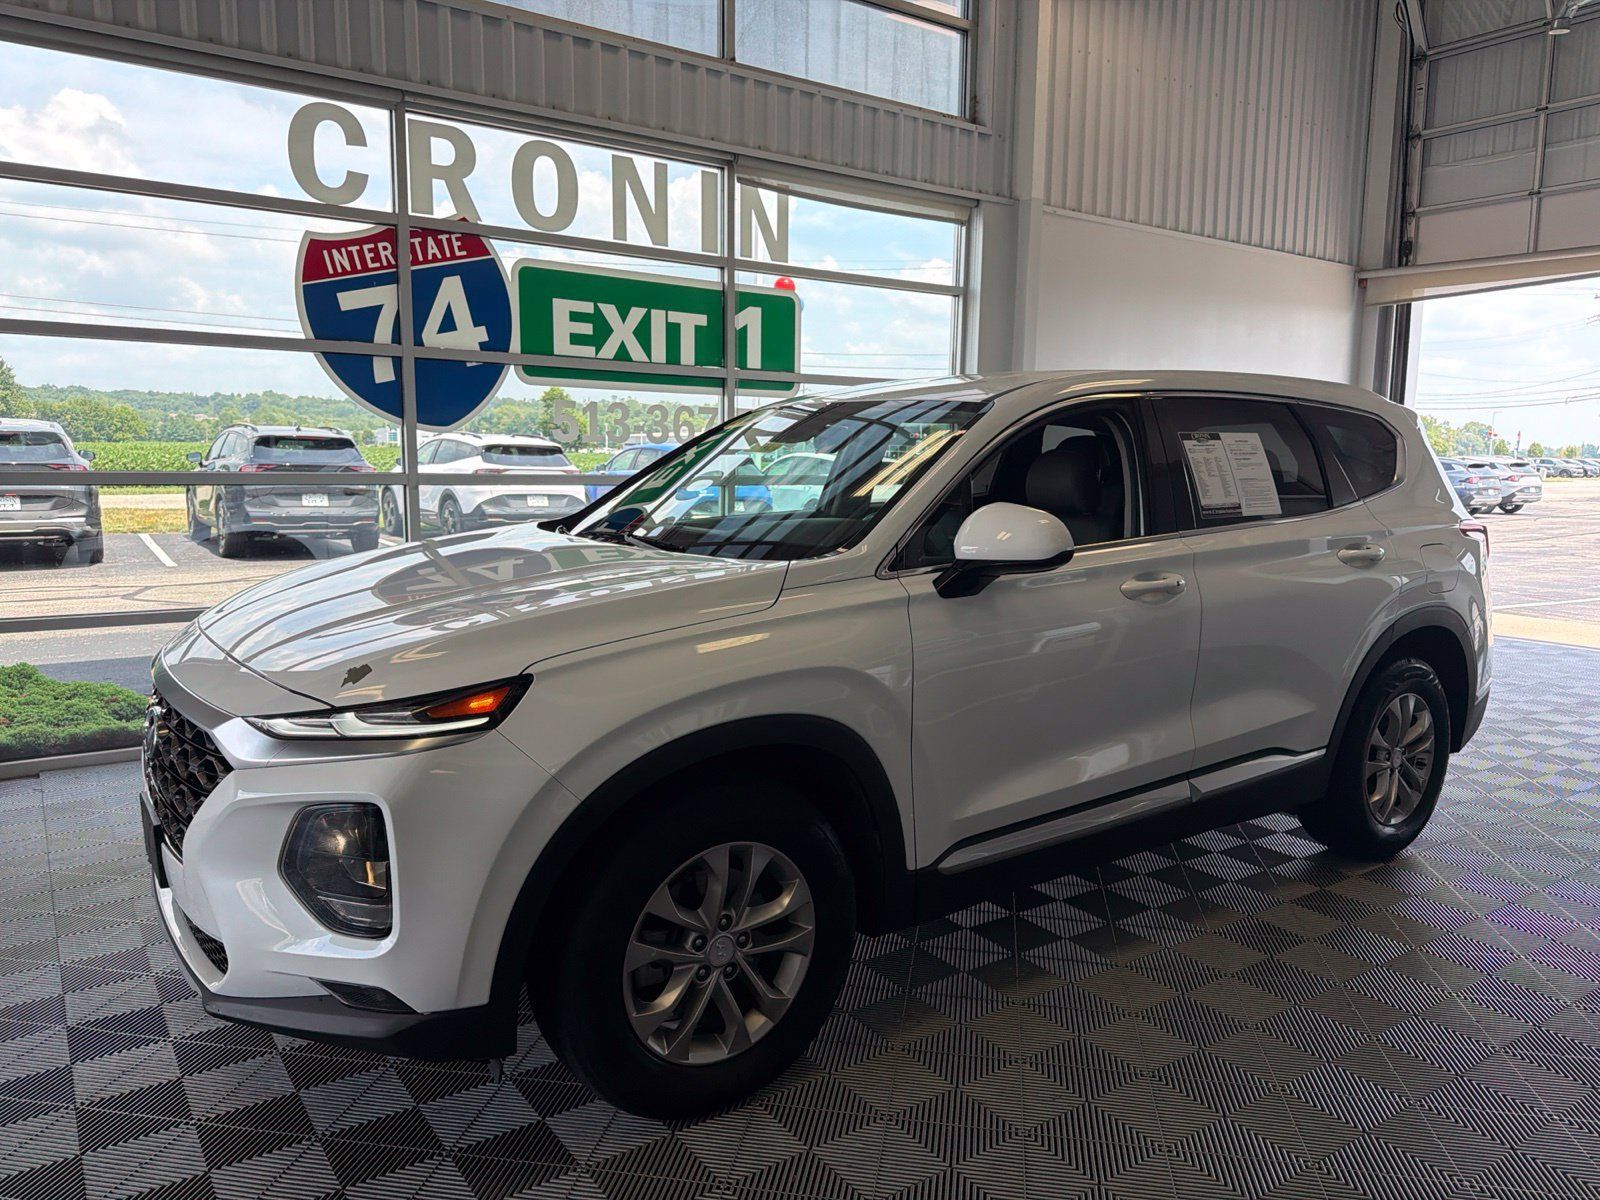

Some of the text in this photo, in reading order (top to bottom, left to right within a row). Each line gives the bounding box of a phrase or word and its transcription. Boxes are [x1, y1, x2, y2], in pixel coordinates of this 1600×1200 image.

[287, 101, 789, 264] CRONIN
[323, 234, 467, 275] INTERTATE
[336, 275, 490, 384] 74
[552, 297, 762, 369] EXIT 1
